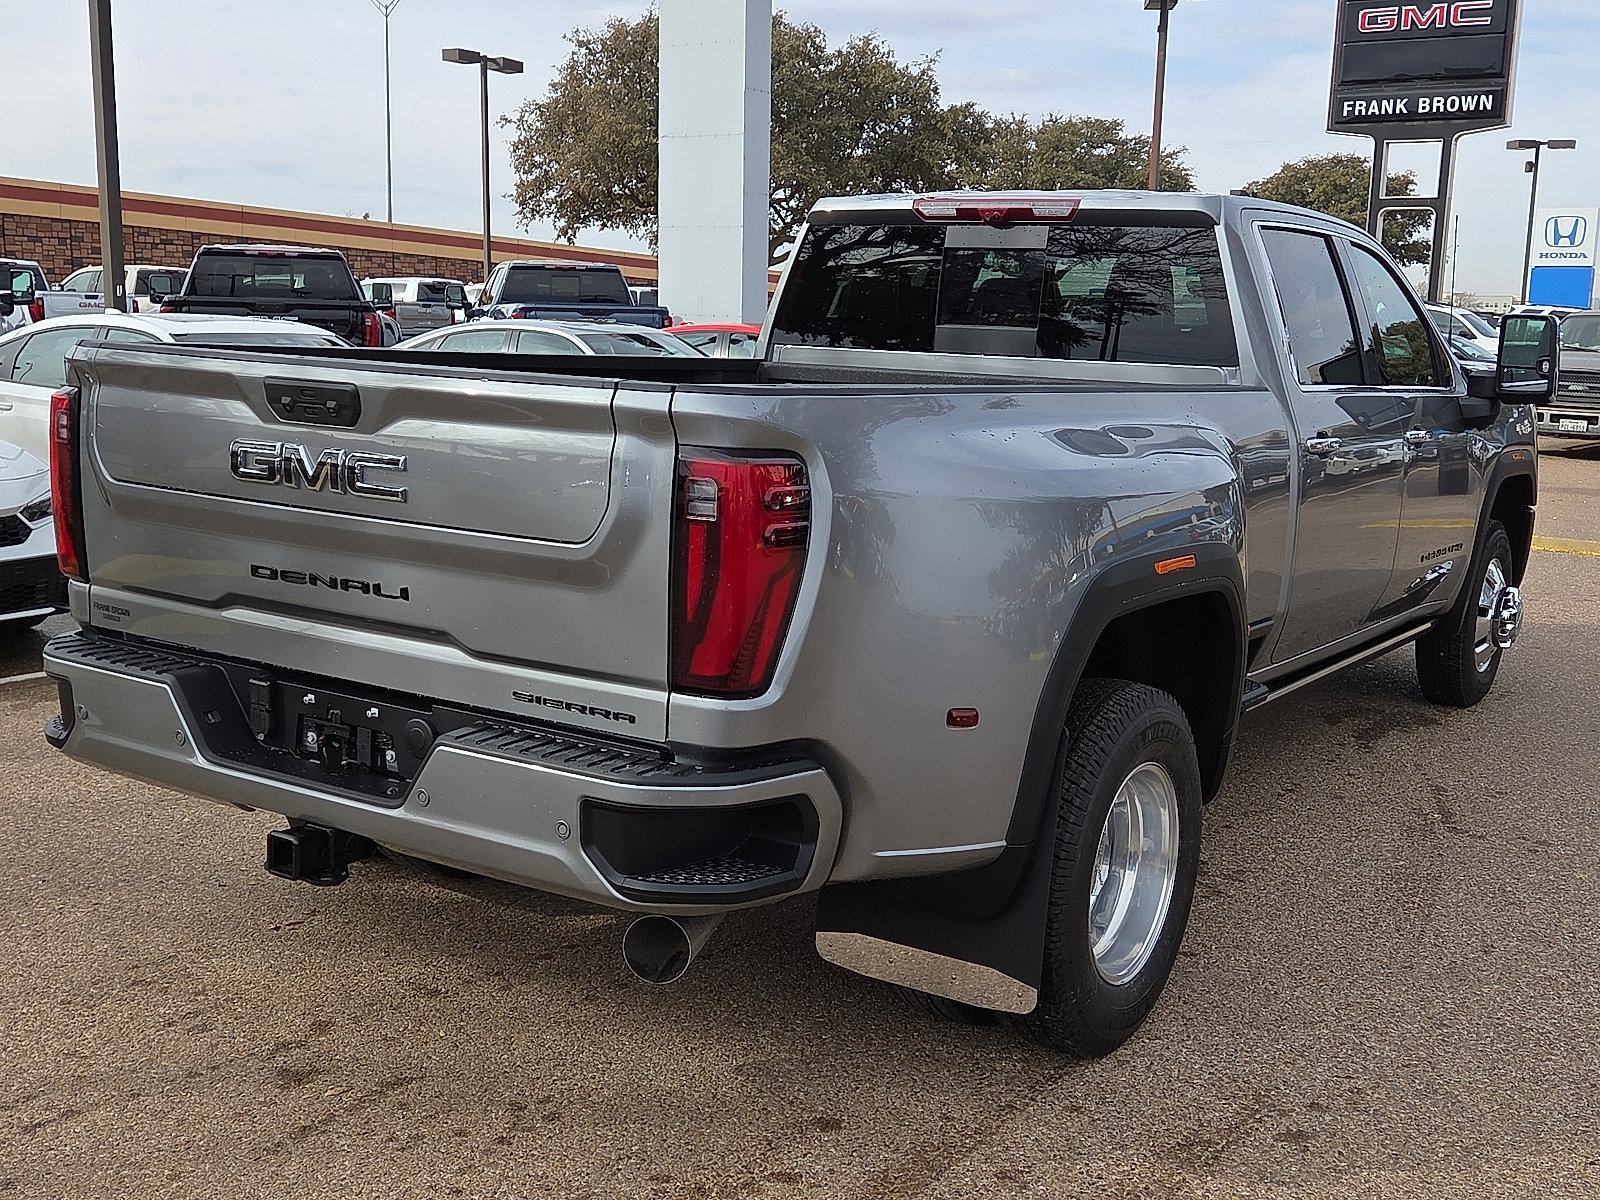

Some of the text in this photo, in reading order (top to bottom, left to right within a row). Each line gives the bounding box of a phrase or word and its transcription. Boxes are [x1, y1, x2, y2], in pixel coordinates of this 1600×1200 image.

[1358, 0, 1493, 33] GMC
[1342, 94, 1493, 117] FRANK BROWN
[230, 438, 408, 502] GMC
[250, 564, 410, 601] DENALI
[512, 690, 636, 724] SIERRA
